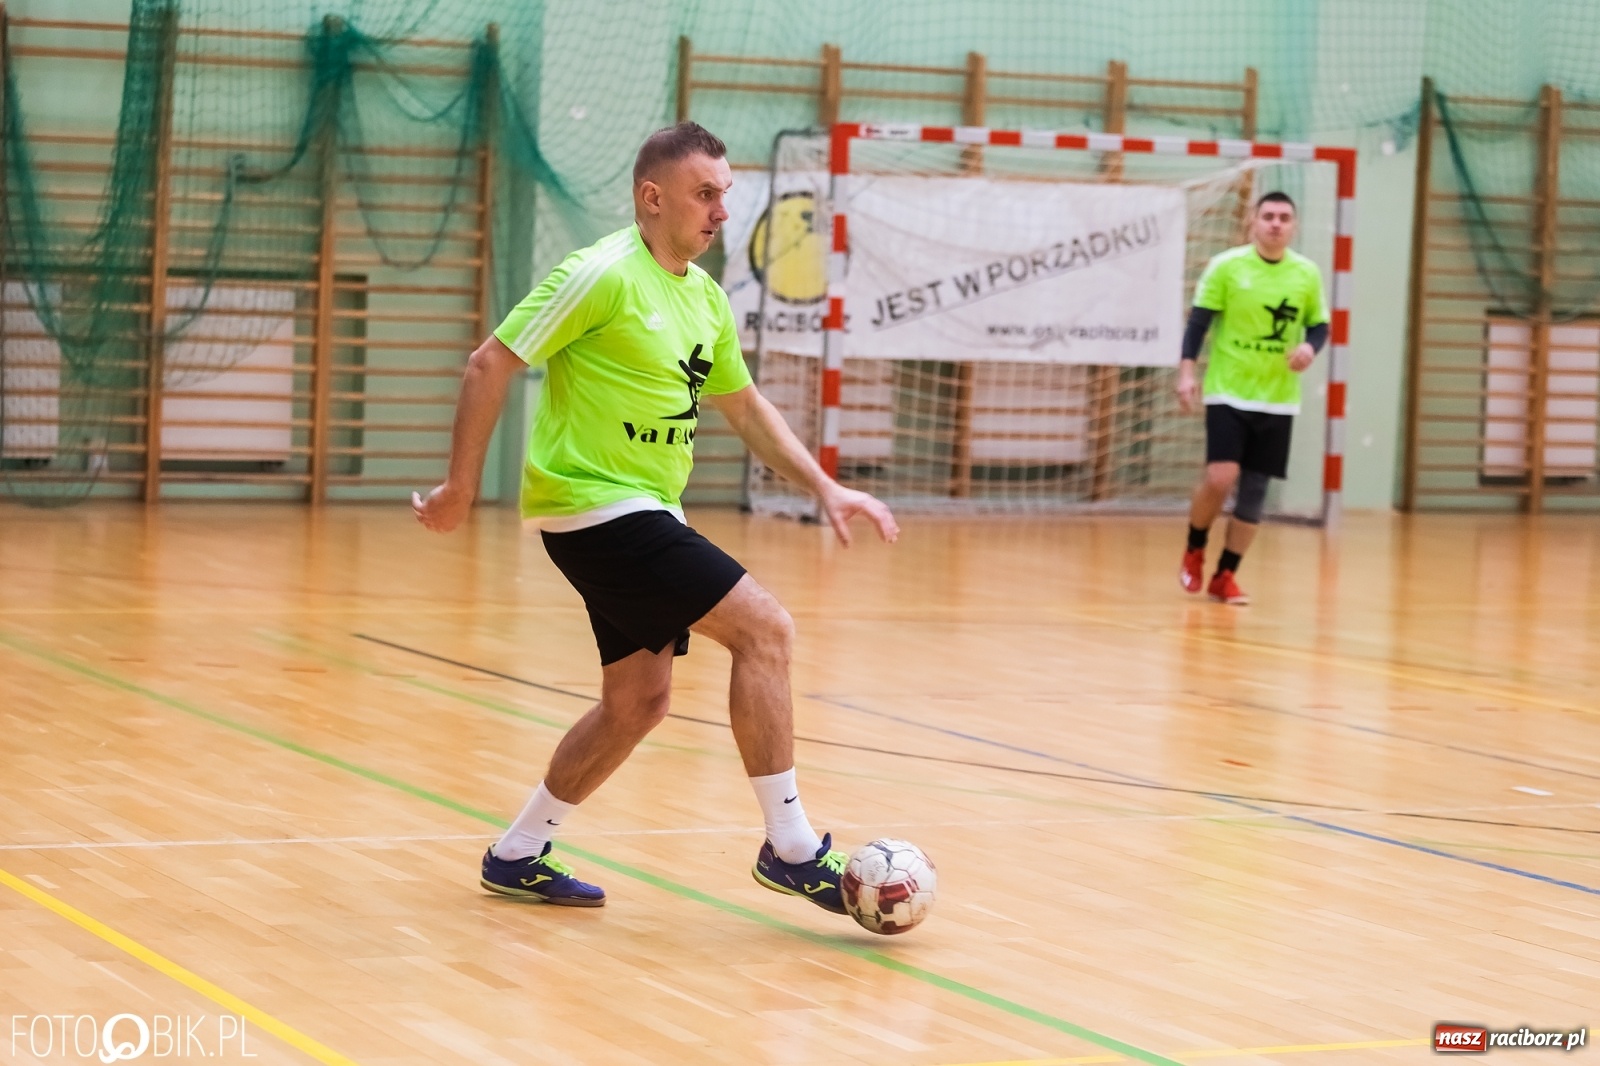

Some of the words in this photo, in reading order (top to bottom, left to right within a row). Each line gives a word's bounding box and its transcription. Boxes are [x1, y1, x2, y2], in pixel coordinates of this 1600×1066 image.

[871, 280, 944, 327] JEST
[953, 267, 982, 299] W
[623, 421, 658, 443] Va
